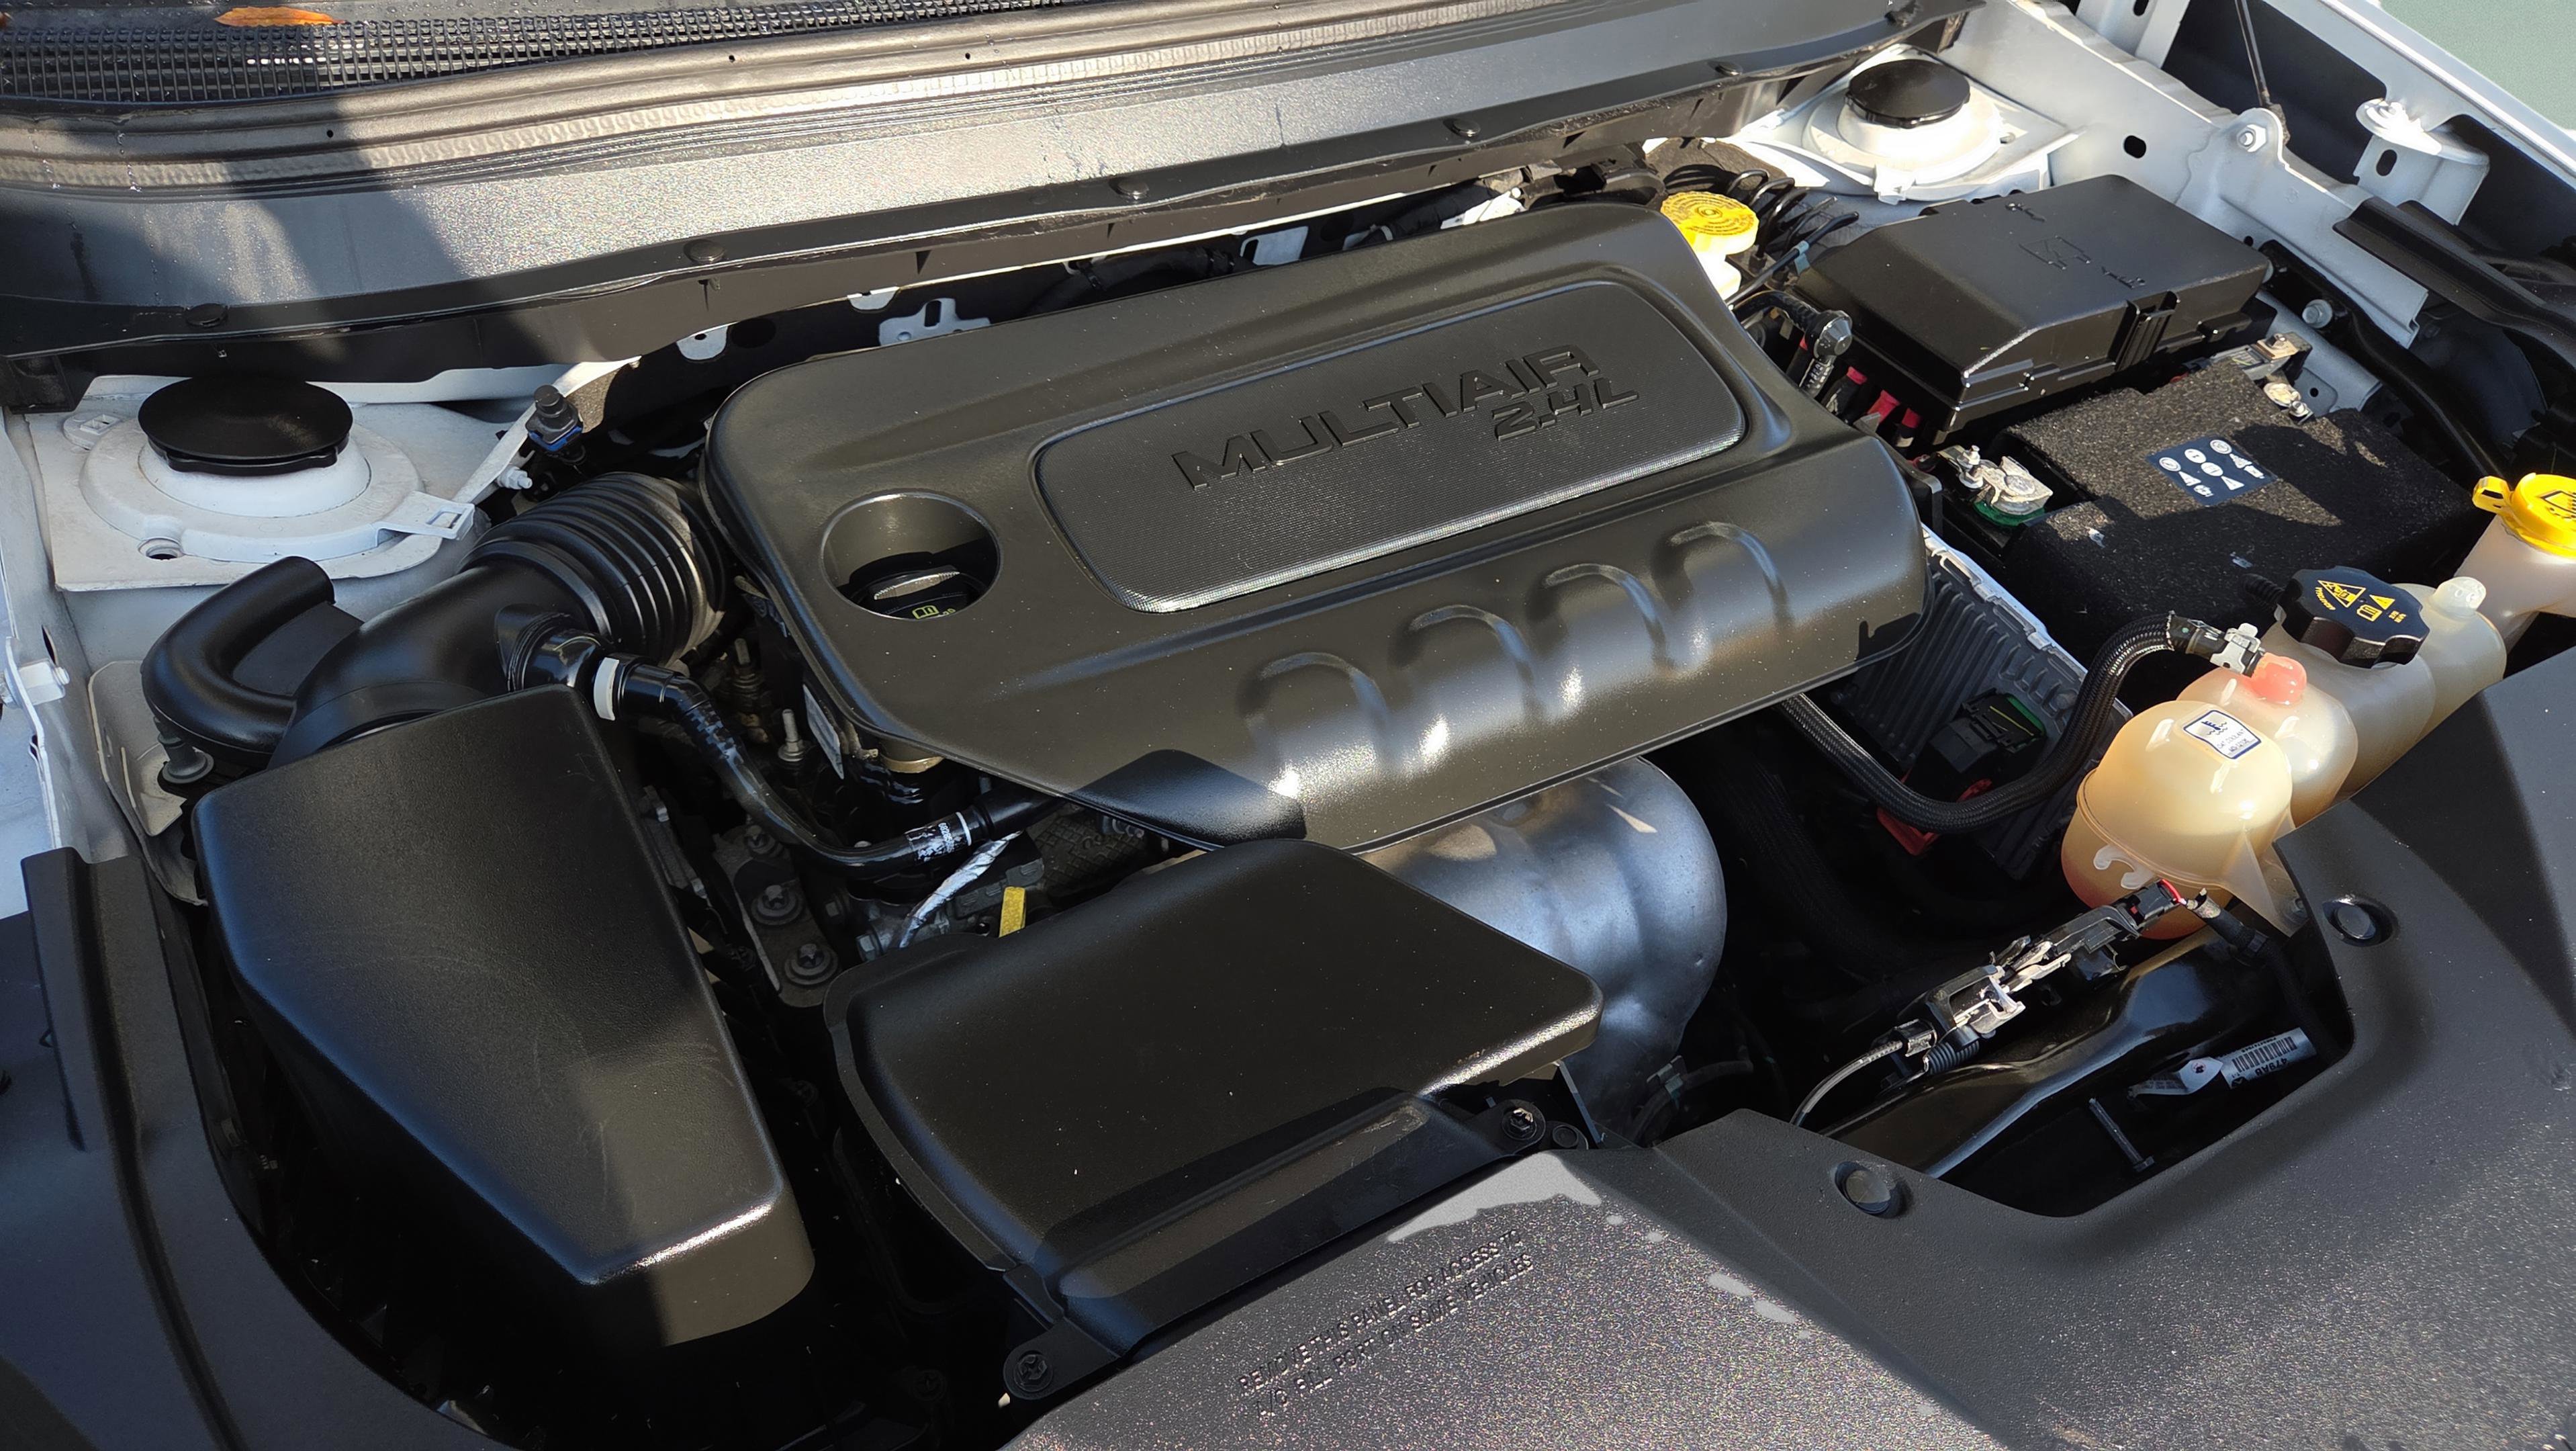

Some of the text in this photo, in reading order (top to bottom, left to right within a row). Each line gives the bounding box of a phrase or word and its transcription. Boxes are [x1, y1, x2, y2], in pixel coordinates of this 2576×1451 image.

[1171, 344, 1600, 490] MULTIAIR
[1491, 377, 1640, 441] 2.4L
[1239, 1229, 1524, 1397] REMOVE THIS PANEL FOR ACCESS TO
[1293, 1367, 1334, 1397] FILL
[1333, 1337, 1375, 1375] PORT
[1381, 1320, 1410, 1348] ON
[1410, 1296, 1459, 1333] SOME
[1457, 1254, 1534, 1305] VEHICLES
